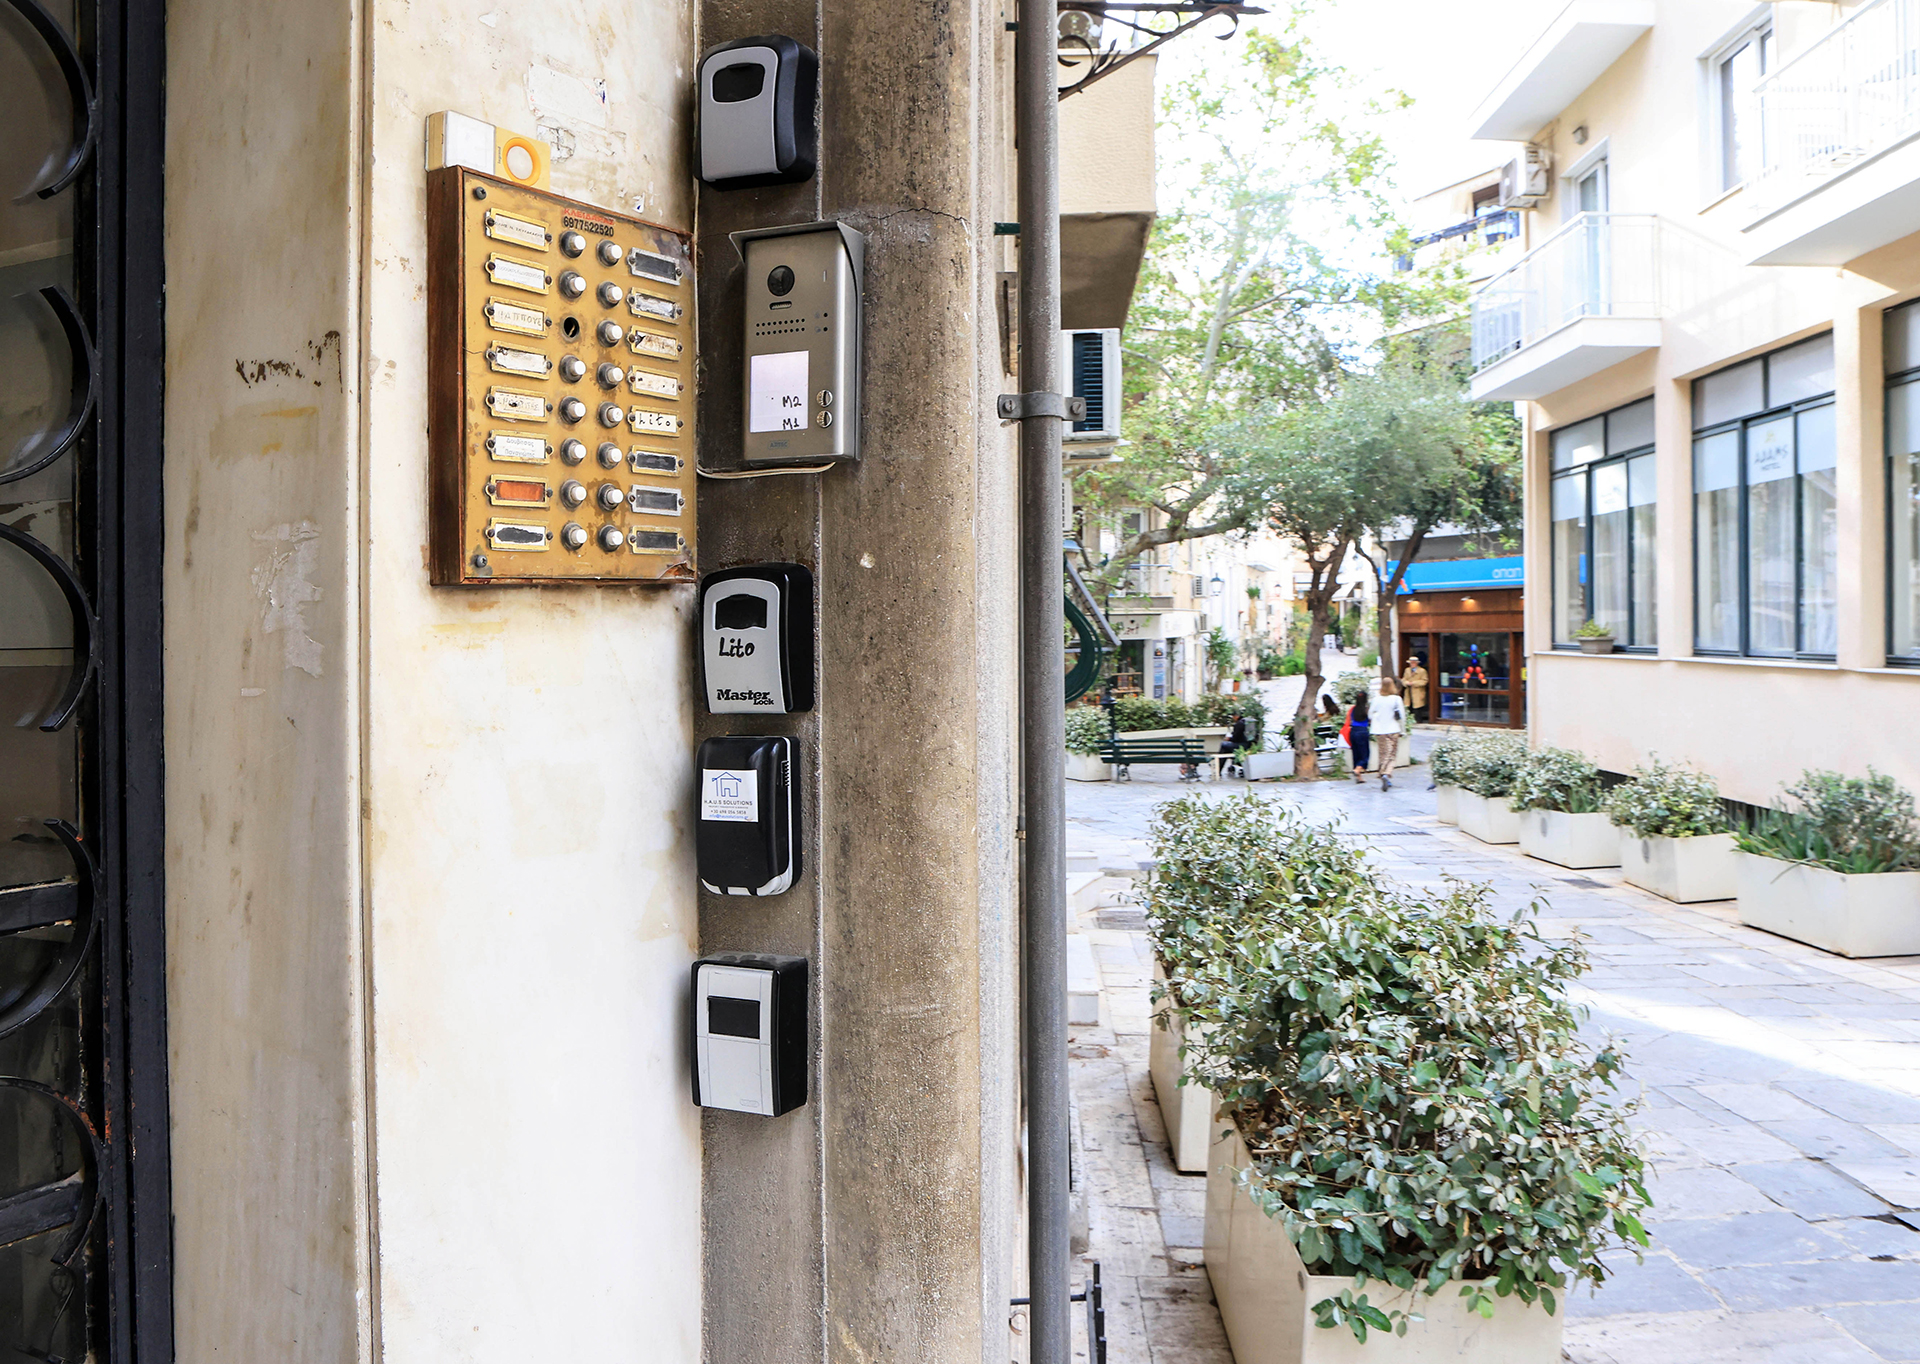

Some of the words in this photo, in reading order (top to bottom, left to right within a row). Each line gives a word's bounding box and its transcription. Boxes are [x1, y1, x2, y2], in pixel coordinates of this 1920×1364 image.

[563, 216, 615, 237] 6977522520
[782, 395, 802, 408] M2
[782, 417, 800, 430] M1
[719, 636, 755, 658] Lito
[716, 688, 770, 701] Master
[753, 698, 774, 706] Lock
